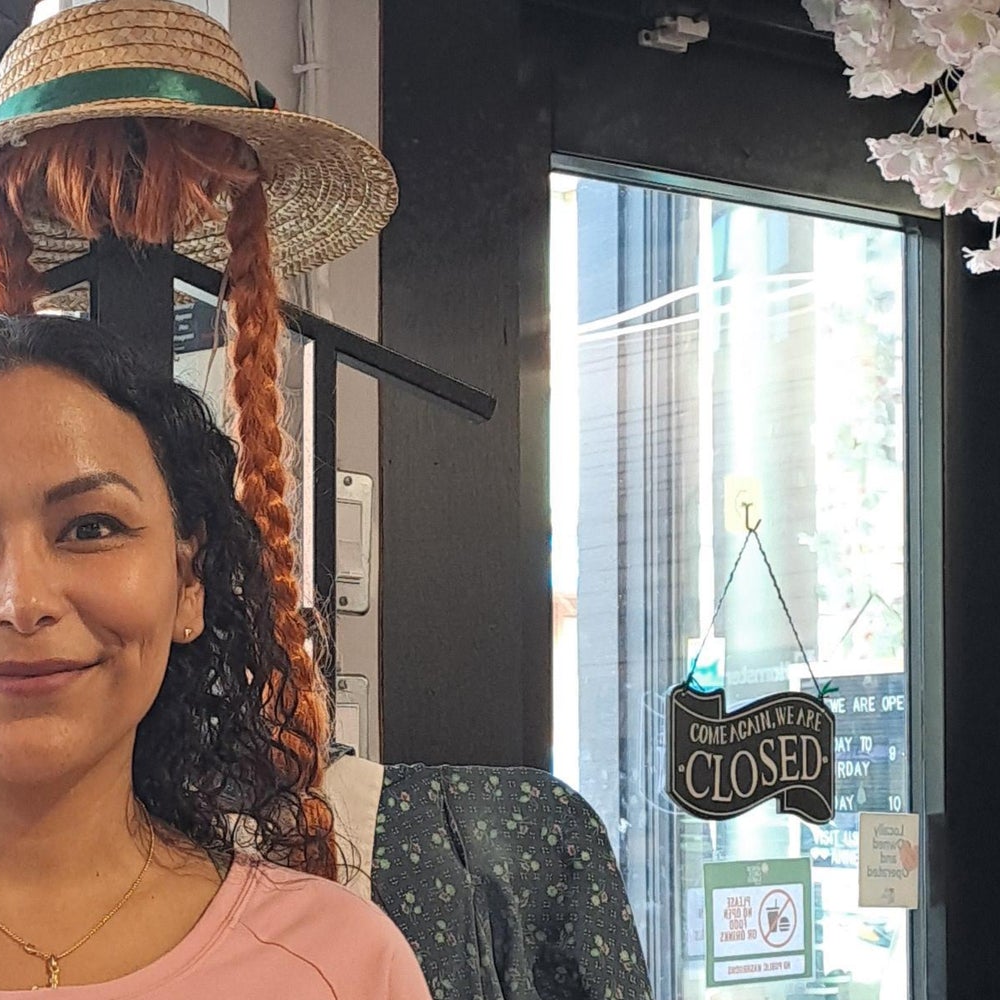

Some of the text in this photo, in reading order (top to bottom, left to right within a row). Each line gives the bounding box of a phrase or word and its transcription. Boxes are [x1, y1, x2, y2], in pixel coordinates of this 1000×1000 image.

[830, 695, 905, 713] WE ARE OPE
[690, 706, 822, 745] COME AGAIN, WE ARE
[860, 735, 873, 753] TO
[888, 745, 896, 761] 8
[685, 734, 823, 802] CLOSED
[837, 760, 870, 778] RDAY
[888, 795, 901, 812] 10
